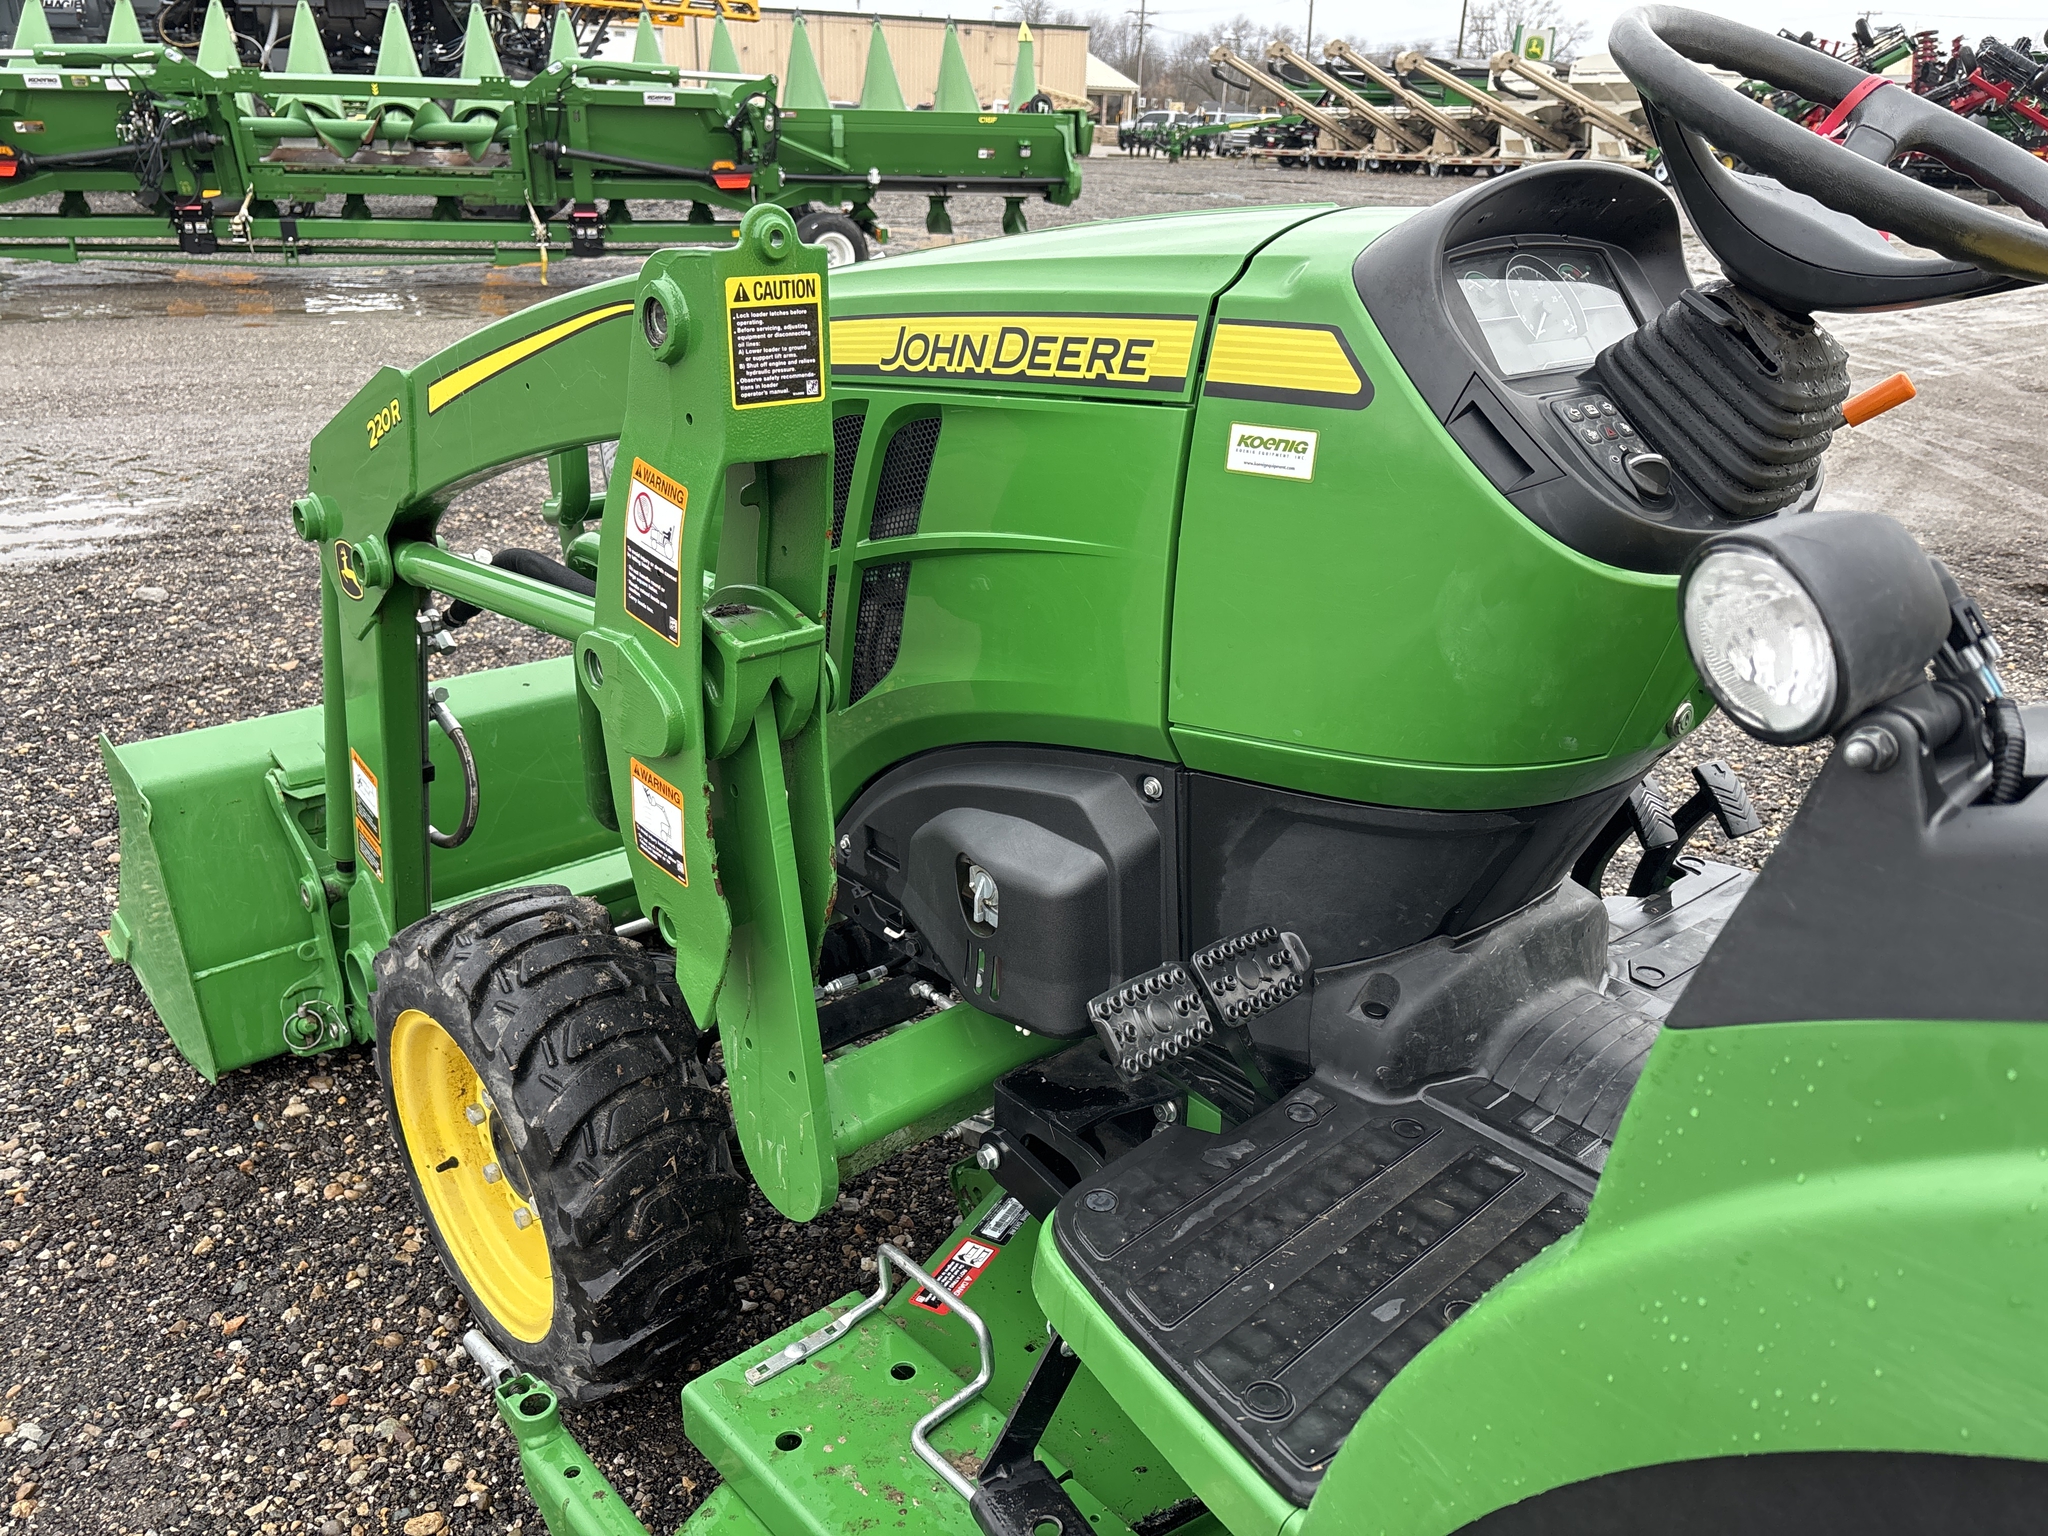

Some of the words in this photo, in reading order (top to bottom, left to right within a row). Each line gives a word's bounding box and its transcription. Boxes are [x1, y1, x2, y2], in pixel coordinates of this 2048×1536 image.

[753, 279, 816, 301] CAUTION
[880, 326, 989, 368] JOHN
[992, 326, 1155, 376] DEERE
[643, 466, 684, 505] WARNING
[639, 767, 681, 804] WARNING
[953, 1280, 969, 1297] DANG
